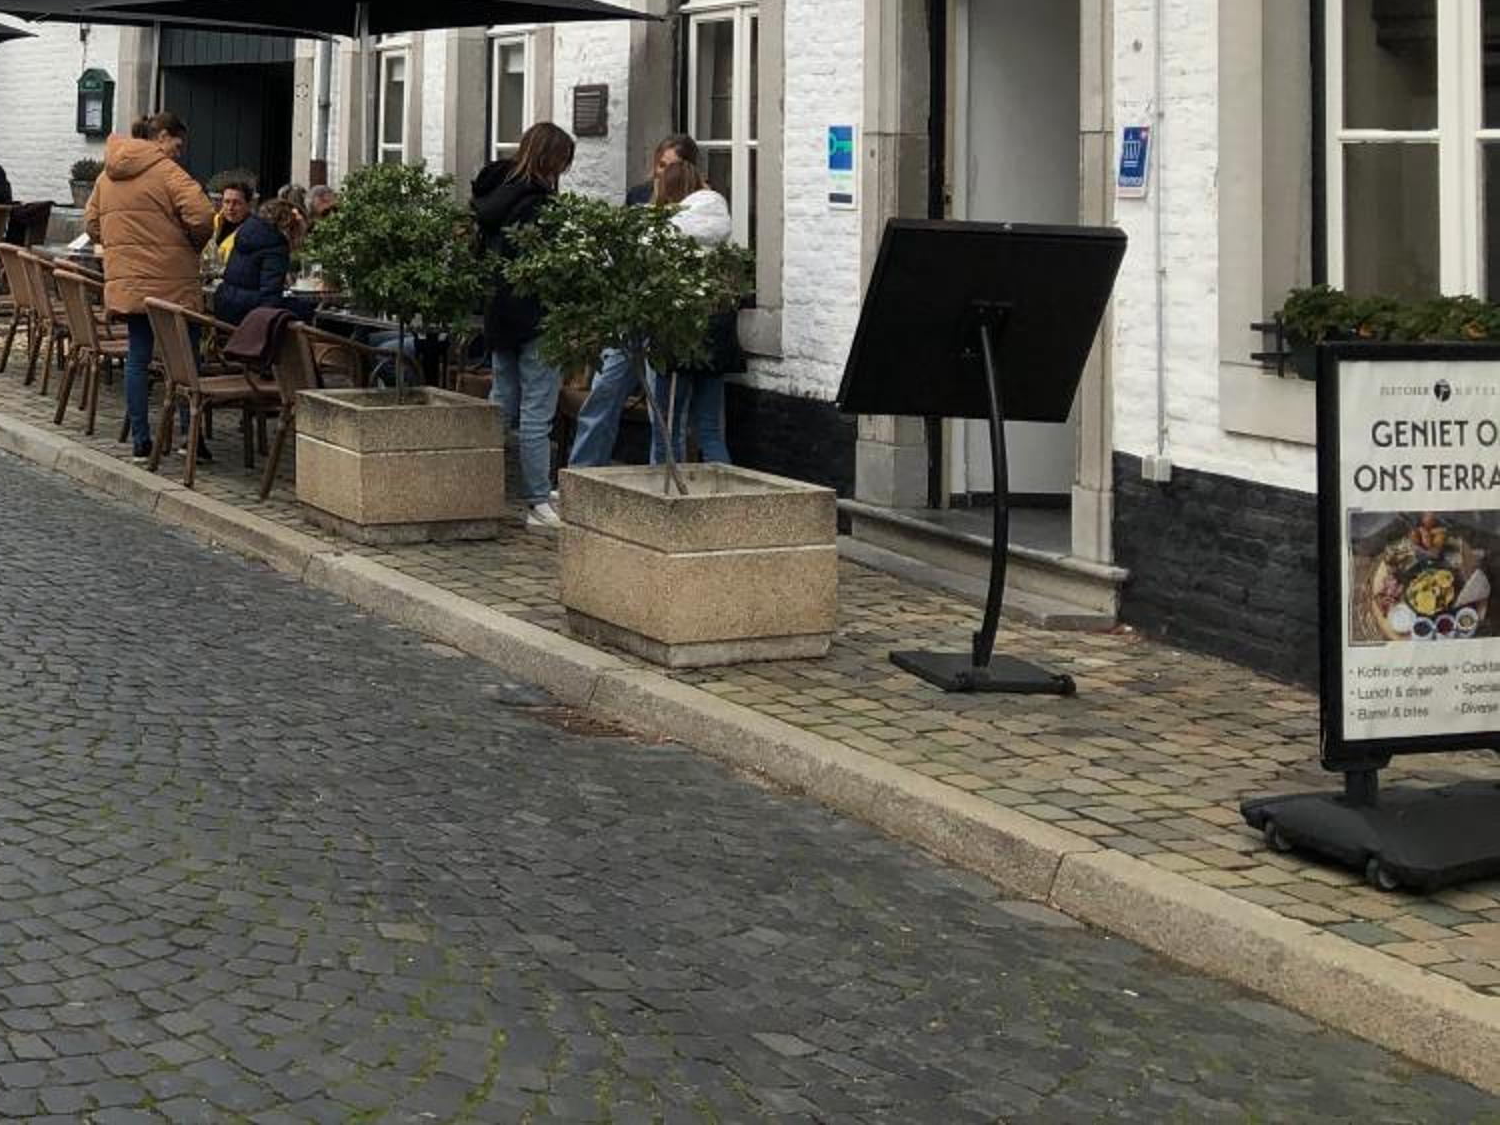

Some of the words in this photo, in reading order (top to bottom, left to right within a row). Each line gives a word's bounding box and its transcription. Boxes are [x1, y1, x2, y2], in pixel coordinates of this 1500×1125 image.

[1371, 420, 1469, 448] GENIET
[1353, 465, 1414, 492] ONS
[1357, 687, 1392, 699] Lunch
